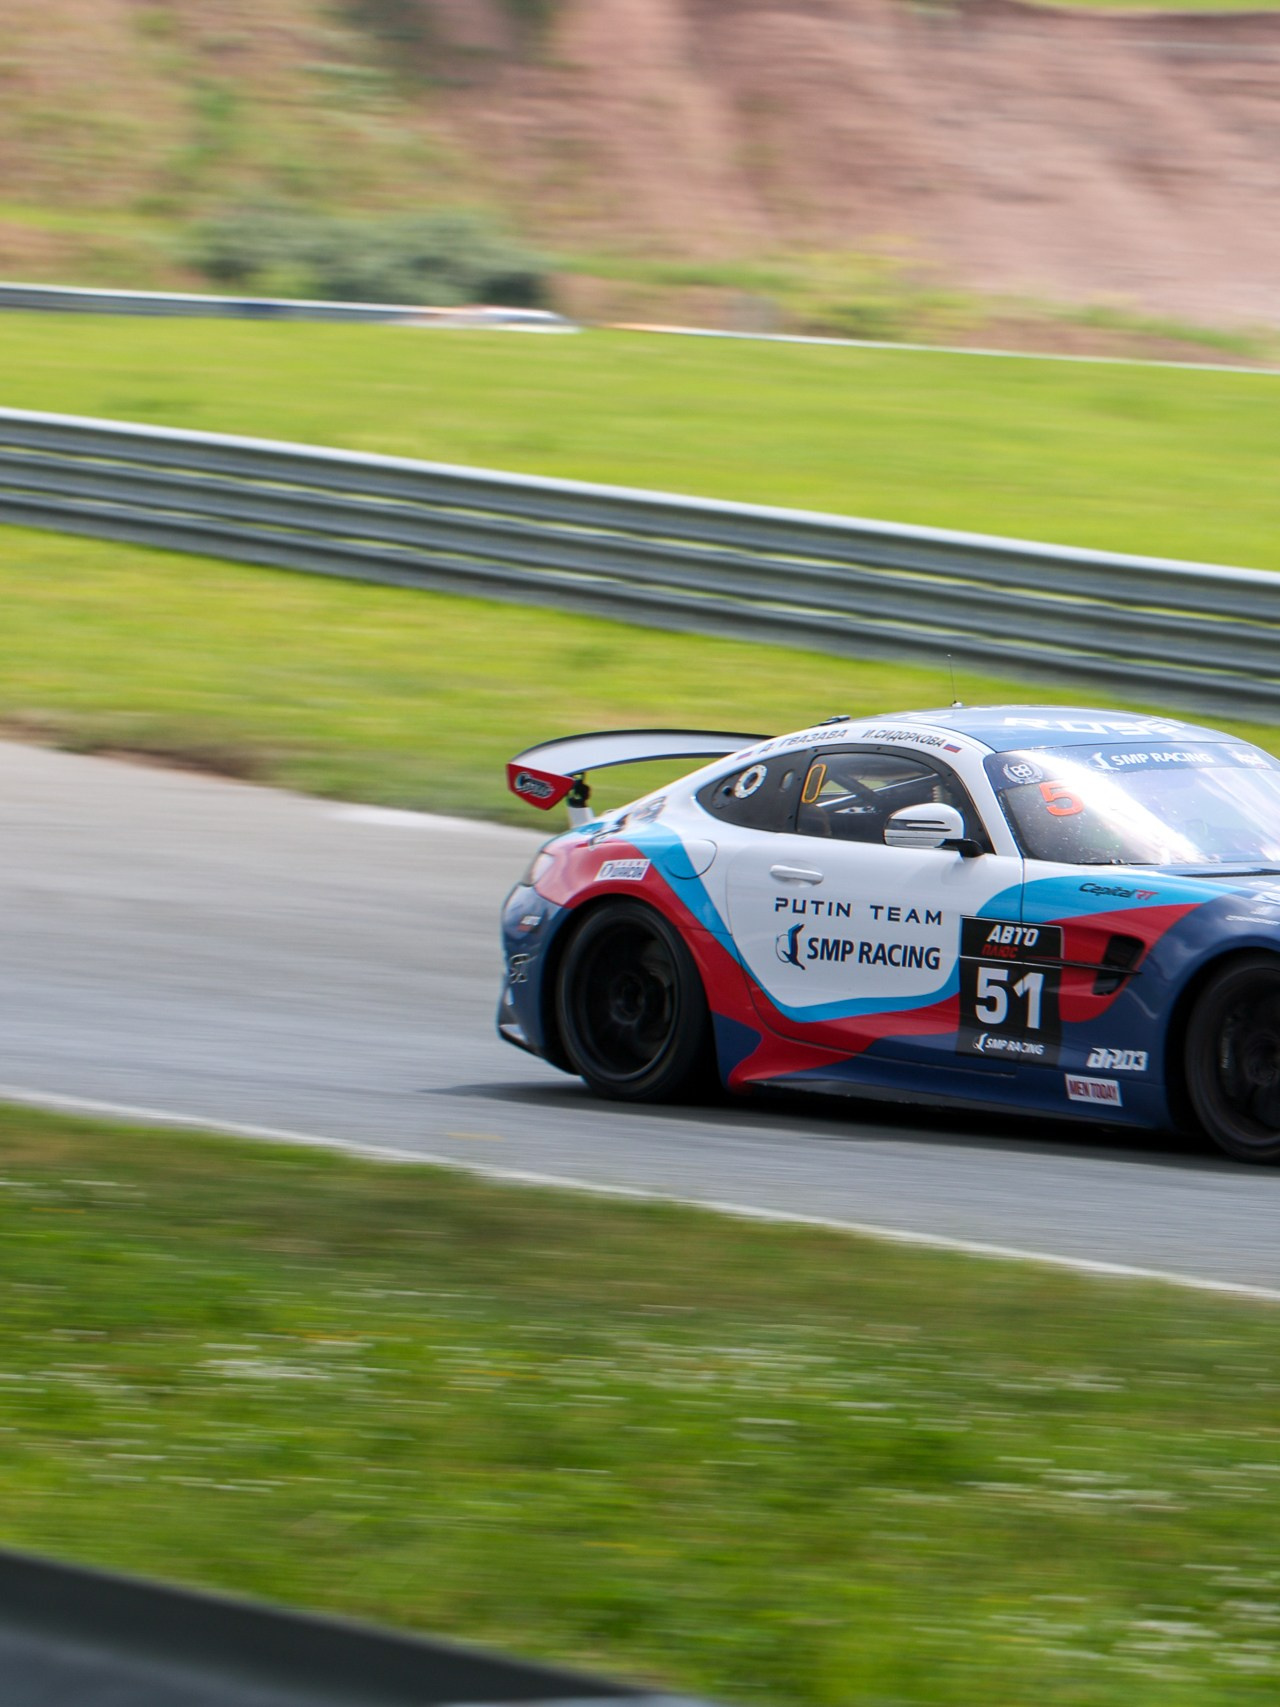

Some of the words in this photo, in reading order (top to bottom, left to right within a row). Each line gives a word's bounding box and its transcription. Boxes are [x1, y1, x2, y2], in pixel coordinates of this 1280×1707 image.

[779, 729, 848, 748] ГВАЗАВА
[861, 729, 947, 748] И.СИДОРКОВА
[1111, 753, 1149, 766] SMP
[1151, 752, 1215, 764] RACING
[775, 897, 851, 918] PUTIN
[869, 904, 943, 926] TEAM
[987, 925, 1040, 947] АВТО
[807, 937, 854, 962] SMP
[858, 941, 941, 970] RACING
[975, 966, 1045, 1029] 51
